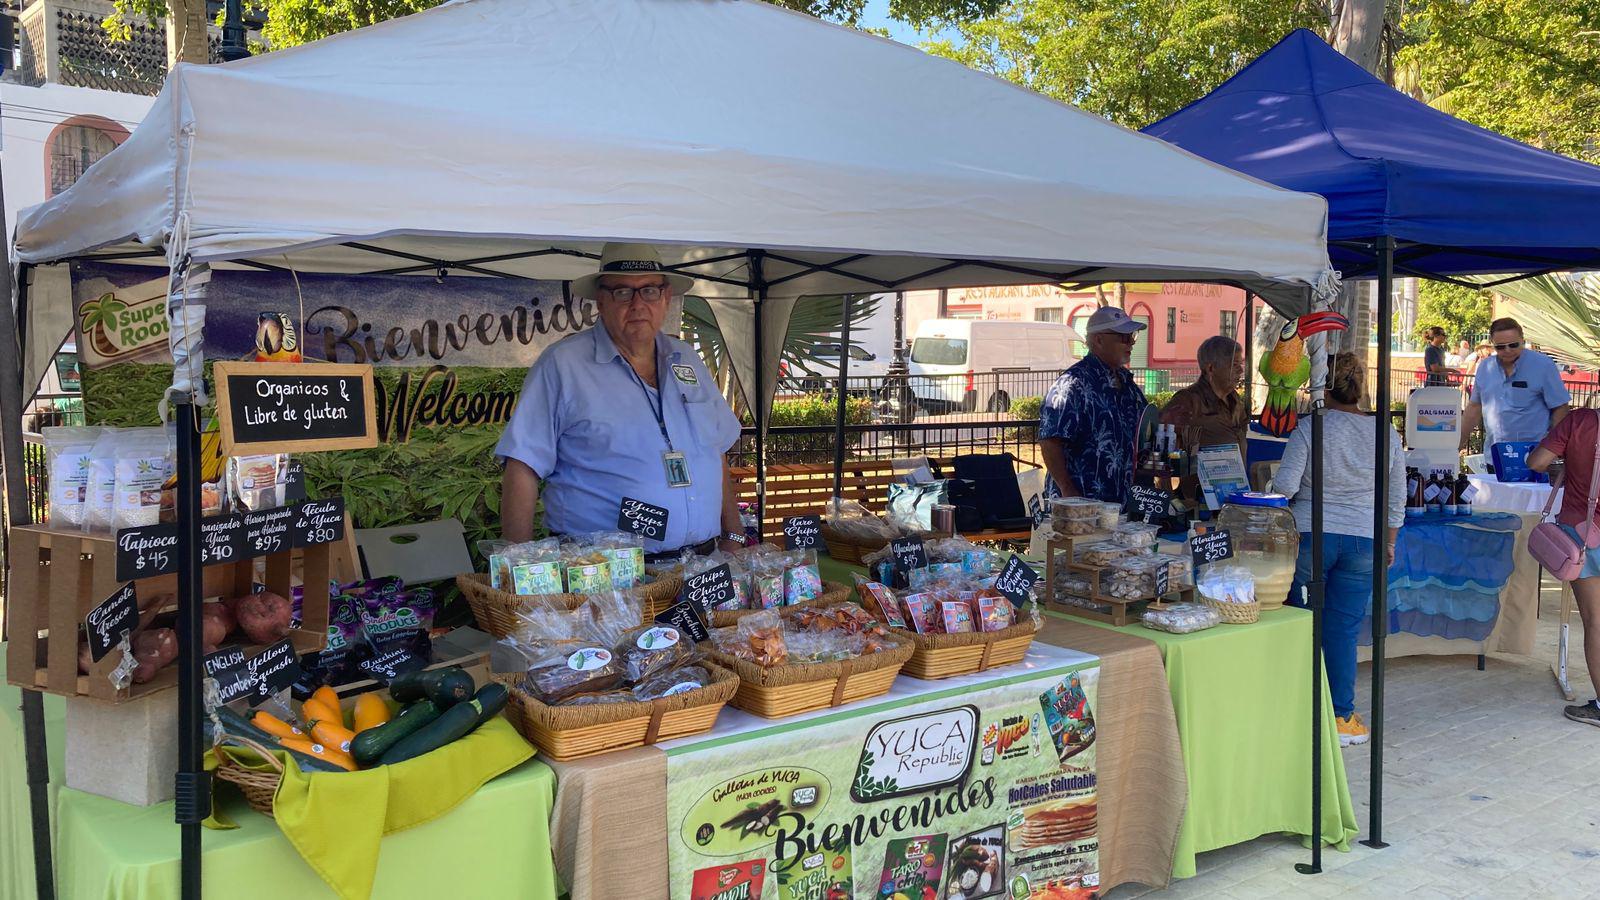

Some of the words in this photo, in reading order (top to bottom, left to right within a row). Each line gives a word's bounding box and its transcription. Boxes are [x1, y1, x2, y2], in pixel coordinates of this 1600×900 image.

[119, 302, 165, 327] Supe
[305, 280, 600, 364] Bienvenido
[120, 317, 169, 347] Root
[256, 379, 329, 406] Organicos
[340, 379, 350, 402] &
[373, 364, 517, 443] Welcom
[244, 405, 278, 425] Libre
[283, 403, 298, 421] de
[304, 402, 348, 430] gluten
[1130, 485, 1158, 497] Dulce
[1158, 490, 1169, 500] de
[1132, 493, 1163, 506] Tapioca
[621, 508, 665, 526] Chips
[625, 500, 666, 517] Yuca
[1138, 503, 1164, 514] $30
[296, 518, 308, 529] de
[310, 515, 343, 530] Yuca
[632, 519, 657, 537] $70
[784, 526, 819, 537] Chips
[789, 516, 814, 527] Taro
[119, 531, 179, 556] Tapioca
[205, 531, 231, 549] Yuca
[255, 534, 281, 552] $95
[306, 527, 335, 543] $80
[1191, 532, 1227, 546] Horchata
[1194, 545, 1203, 553] de
[1204, 541, 1228, 554] Yuca
[1205, 548, 1228, 560] $20
[135, 550, 169, 571] $45
[688, 570, 726, 589] Chips
[995, 557, 1018, 590] Camote
[1005, 568, 1024, 593] Chips
[688, 580, 730, 601] Chicas
[701, 589, 727, 606] $20
[89, 586, 134, 626] Camote
[361, 611, 396, 624] Sinaloa
[366, 616, 419, 633] PRODUCE
[675, 603, 703, 640] Zucchini
[102, 632, 111, 647] $
[205, 651, 245, 675] ENGLISH
[246, 643, 290, 675] Yellow
[360, 646, 407, 670] Zucchini
[371, 653, 412, 674] Squash
[250, 655, 294, 687] Squash
[386, 668, 397, 678] $
[219, 673, 252, 701] ucumber
[259, 682, 268, 696] $
[877, 719, 967, 759] YUCA
[897, 745, 964, 774] Republic
[712, 778, 755, 803] Galletas
[757, 772, 769, 785] de
[771, 769, 801, 784] YUCA
[1008, 782, 1050, 804] HotCakes
[765, 775, 1000, 874] Bienvenidos
[1066, 846, 1077, 854] de
[890, 859, 922, 879] TARO
[788, 865, 828, 899] YUCA
[896, 870, 928, 890] chips
